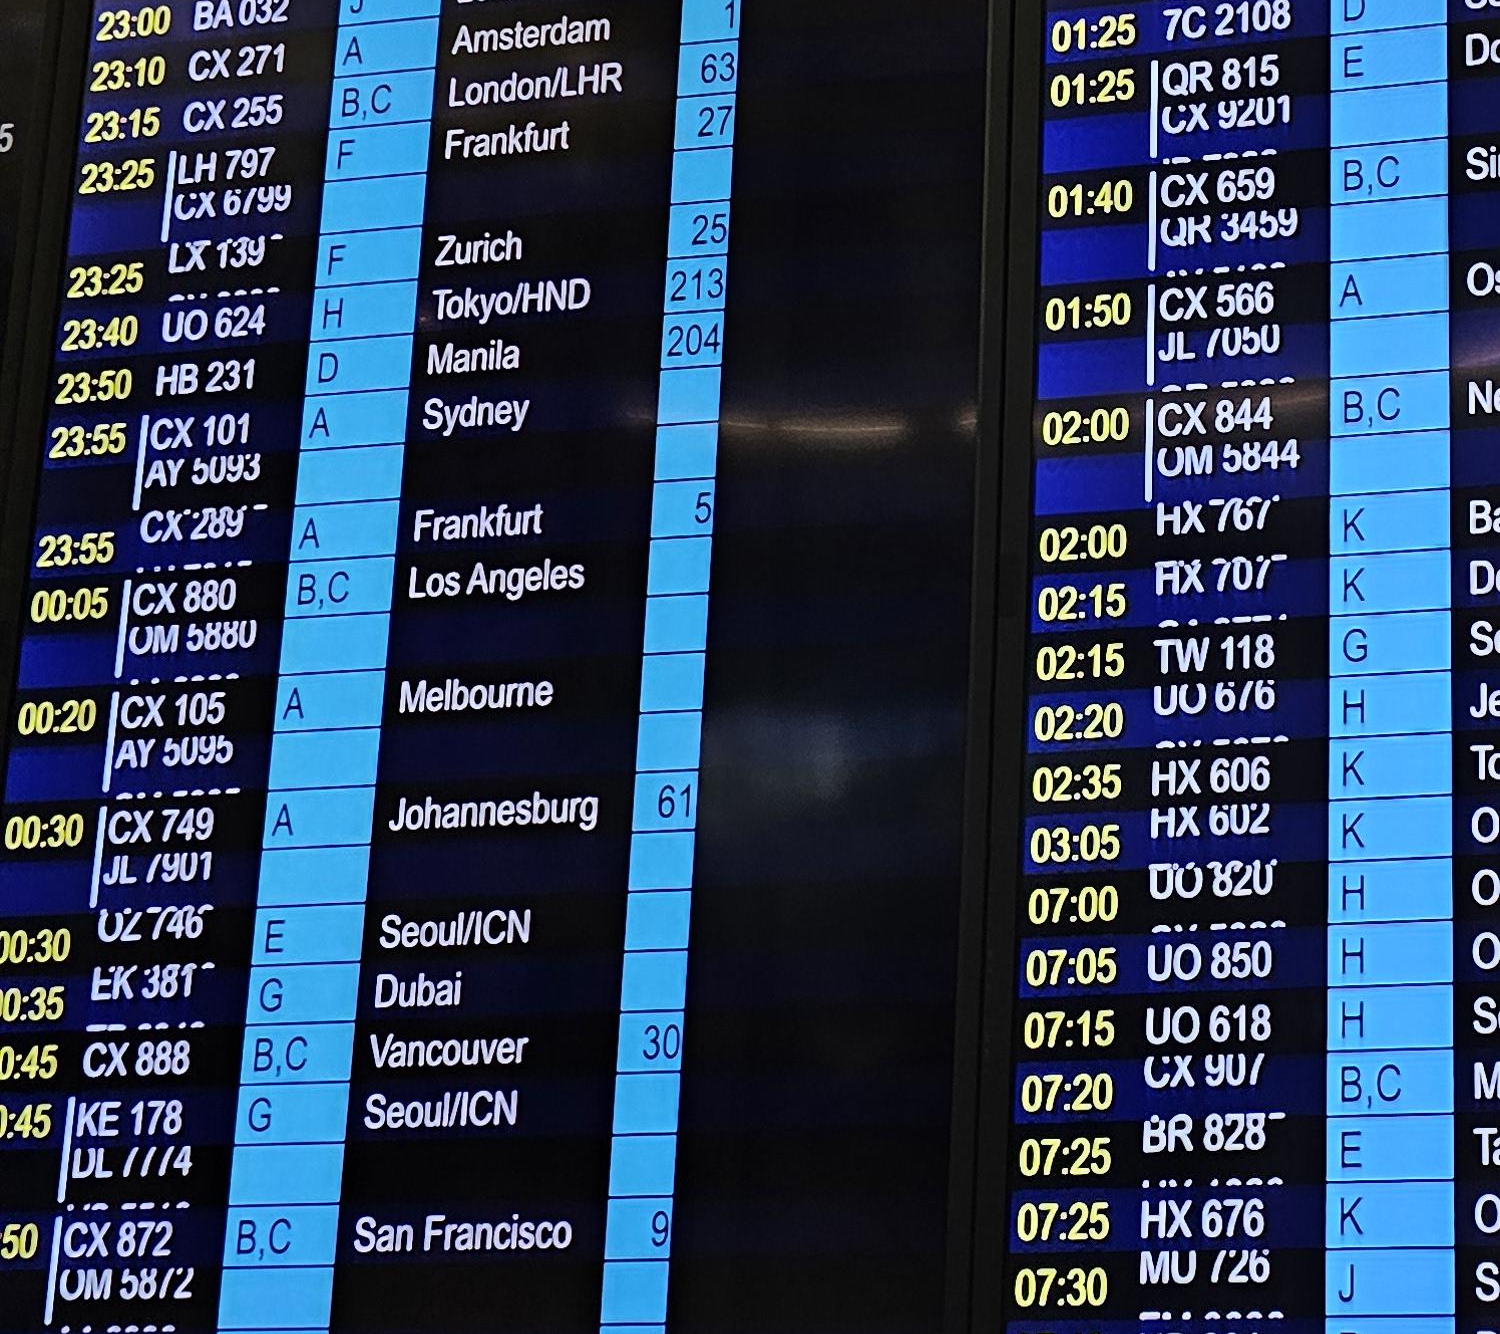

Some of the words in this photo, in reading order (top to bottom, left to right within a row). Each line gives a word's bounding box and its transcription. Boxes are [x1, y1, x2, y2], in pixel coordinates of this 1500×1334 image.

[95, 5, 171, 42] 23:00
[89, 55, 166, 92] 23:10
[188, 48, 232, 82] CX
[236, 42, 286, 77] 271
[342, 35, 363, 66] A
[451, 15, 611, 56] Amsterdam
[1048, 179, 1133, 218] 01:40
[1160, 172, 1209, 208] CX
[1216, 166, 1275, 203] 659
[1343, 155, 1400, 196] B,C
[60, 315, 138, 352] 23:40
[161, 309, 209, 343] UO
[214, 304, 266, 339] 624
[322, 297, 344, 330] H
[431, 277, 591, 325] Tokyo/HND
[670, 267, 724, 303] 213
[1042, 407, 1130, 446] 02:00
[1157, 401, 1207, 438] CX
[1214, 396, 1274, 434] 844
[1343, 387, 1401, 428] B,C
[1032, 763, 1122, 803] 02:35
[1151, 758, 1202, 797] HX
[1209, 755, 1271, 794] 606
[1342, 750, 1365, 788] K
[388, 790, 599, 832] Johannesburg
[657, 783, 691, 819] 61
[369, 1033, 530, 1069] Vancouver
[642, 1023, 681, 1061] 30
[353, 1215, 414, 1253] San
[423, 1213, 573, 1252] Francisco
[651, 1210, 669, 1248] 9
